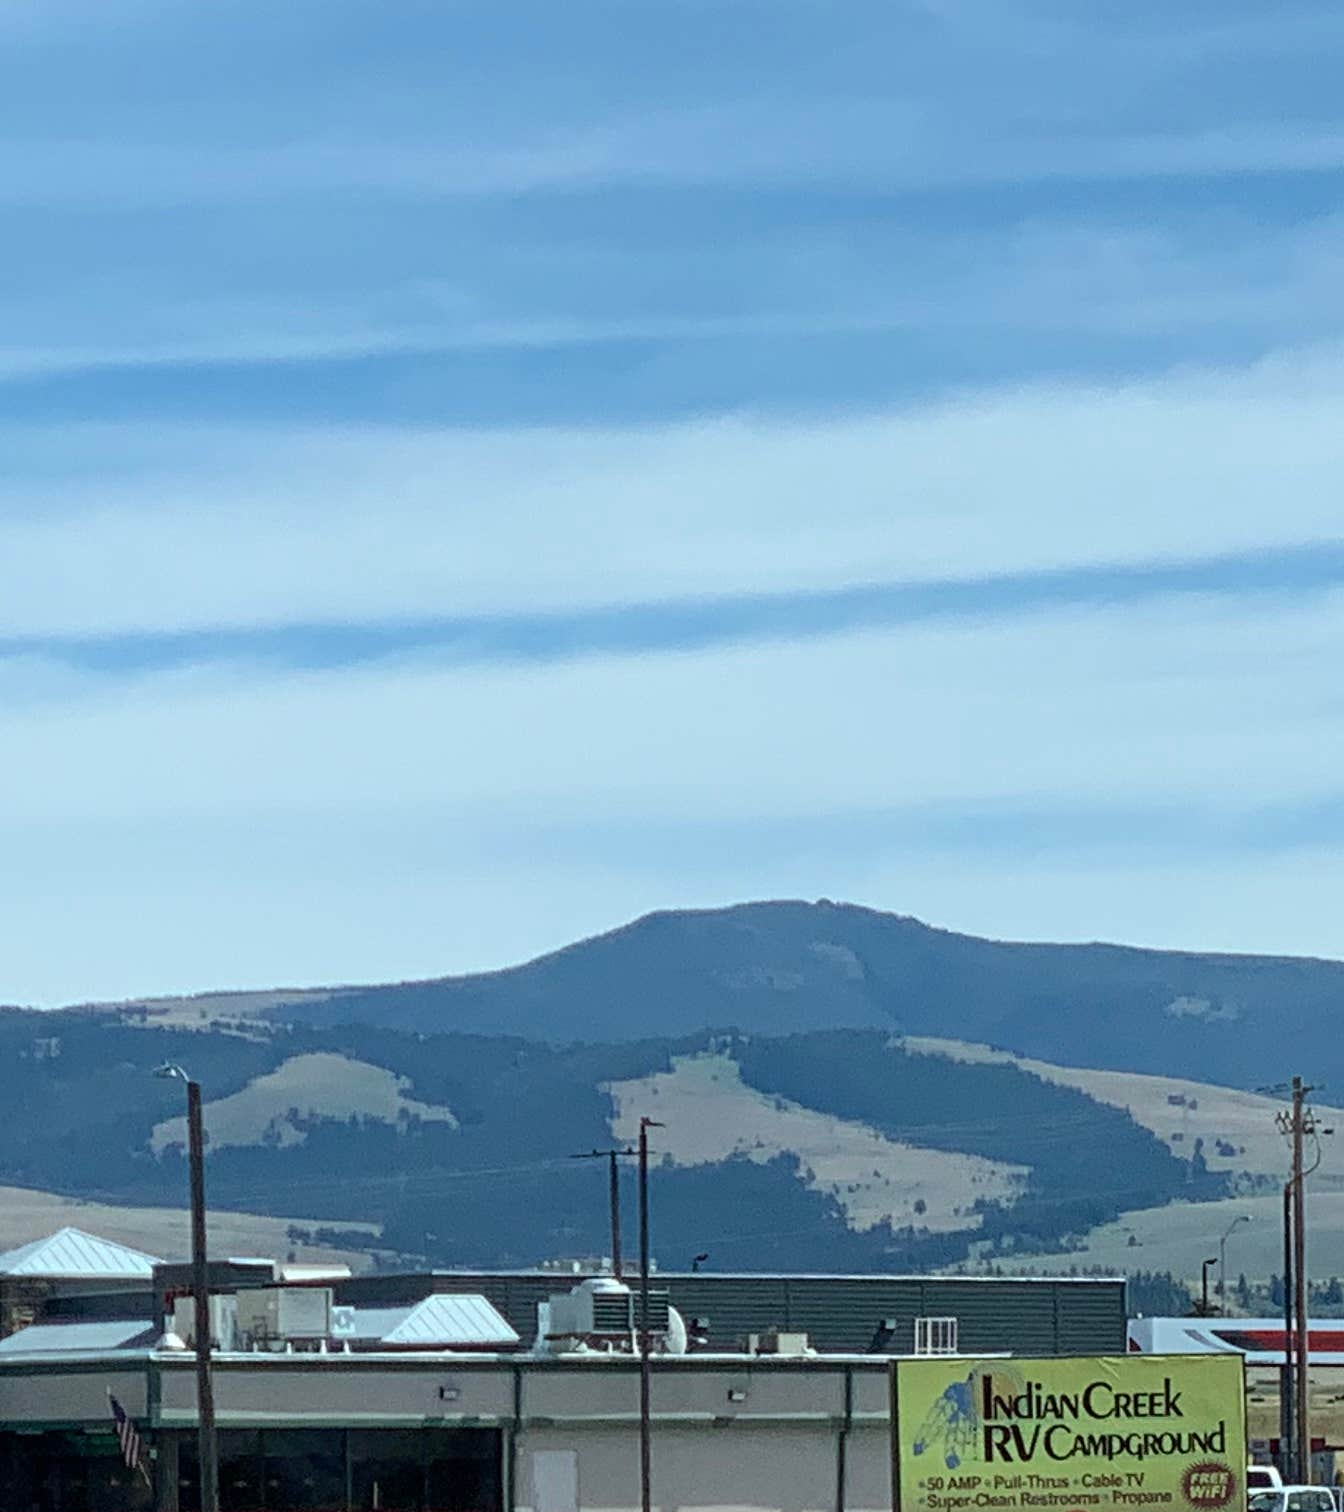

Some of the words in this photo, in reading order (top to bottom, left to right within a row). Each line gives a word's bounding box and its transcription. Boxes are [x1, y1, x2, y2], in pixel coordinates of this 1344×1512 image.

[983, 1423, 1041, 1463] RV
[926, 1476, 945, 1491] 50
[946, 1476, 982, 1490] AMP
[993, 1474, 1070, 1490] Pull-Thrus
[1081, 1473, 1123, 1488] Cable
[1126, 1472, 1145, 1487] TV
[1190, 1472, 1229, 1485] FREE
[1020, 1491, 1101, 1507] Restrooms
[1112, 1489, 1173, 1506] Propane
